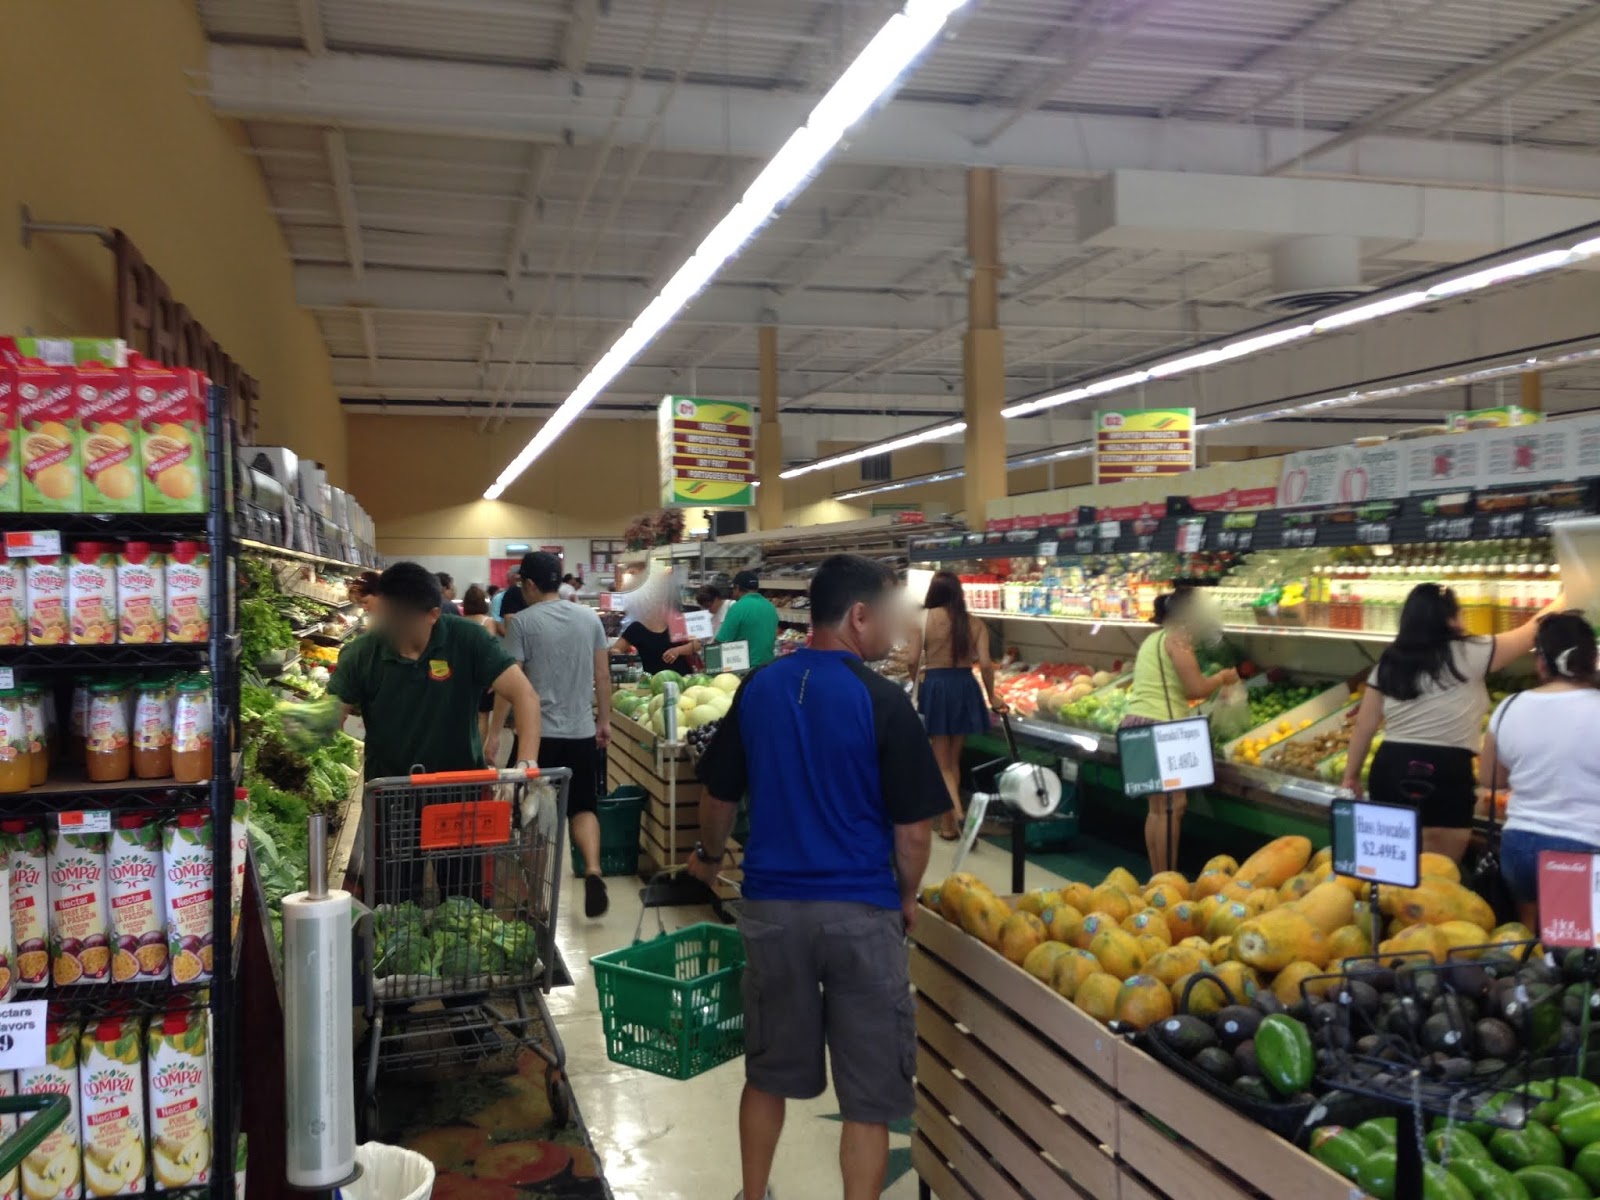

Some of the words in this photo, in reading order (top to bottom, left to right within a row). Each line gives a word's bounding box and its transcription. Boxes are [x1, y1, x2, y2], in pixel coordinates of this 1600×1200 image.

[168, 864, 213, 881] COMPa
[60, 896, 88, 909] Nectar
[115, 893, 144, 906] Nectar
[177, 893, 206, 906] Nectar
[162, 1101, 192, 1117] Nectar
[92, 1109, 122, 1125] Nectar
